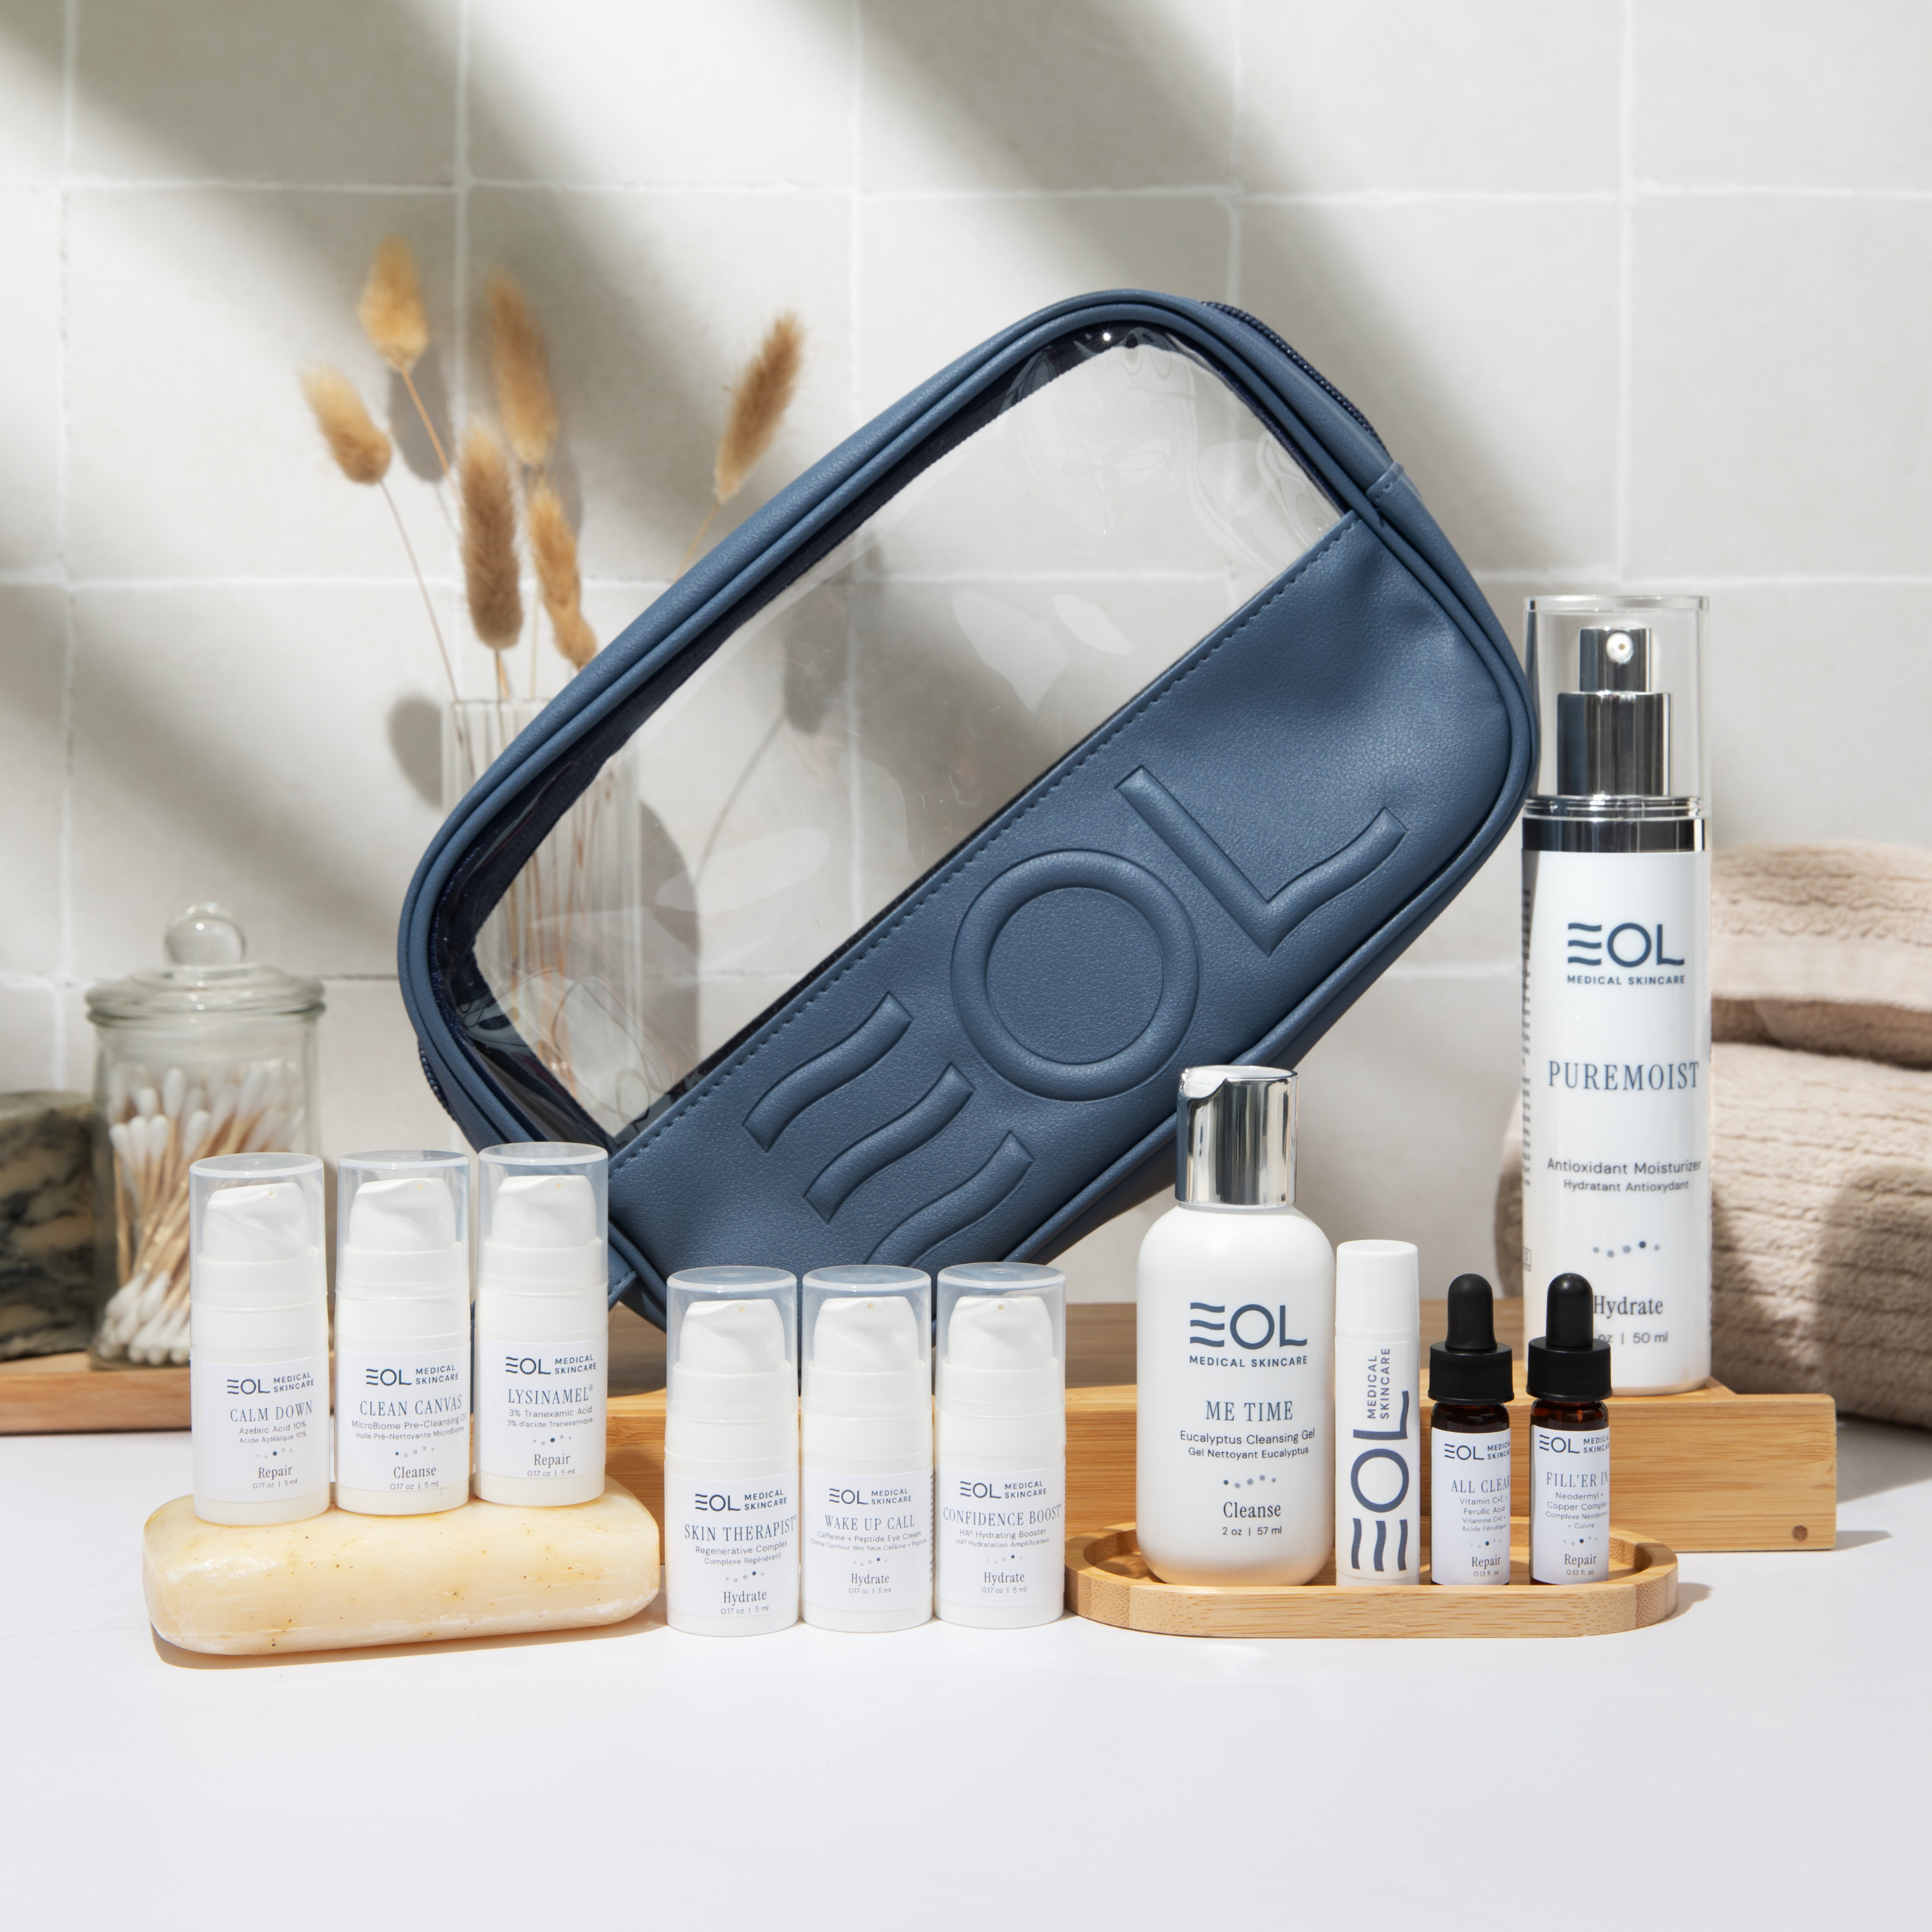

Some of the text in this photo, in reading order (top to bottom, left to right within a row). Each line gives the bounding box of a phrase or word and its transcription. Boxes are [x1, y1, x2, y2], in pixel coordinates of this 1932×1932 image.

[1567, 922, 1685, 967] EOL
[1567, 975, 1685, 985] MEDICAL SKINCARE
[1548, 1060, 1699, 1090] PUREMOIST
[1548, 1158, 1702, 1174] Antioxidant Moisturizer
[1564, 1180, 1689, 1193] Hydratant Antioxydant
[1593, 1295, 1663, 1319] Hydrate
[1190, 1303, 1307, 1350] EOL
[1598, 1332, 1668, 1343] oz 50 ml
[506, 1357, 551, 1375] EOL
[556, 1355, 593, 1365] MEDICAL
[1189, 1355, 1307, 1367] MEDICAL SKINCARE
[416, 1364, 455, 1375] MEDICAL
[555, 1362, 596, 1374] SKINCARE
[274, 1372, 311, 1383] MEDICAL
[366, 1369, 412, 1386] EOL
[416, 1373, 459, 1385] SKINCARE
[1381, 1348, 1390, 1419] SKINCARE
[227, 1379, 270, 1395] EOL
[274, 1379, 314, 1392] SKINCARE
[1367, 1356, 1377, 1419] MEDICAL
[230, 1401, 312, 1422] CALM DOWN
[360, 1395, 462, 1416] CLEAN CANVAS
[525, 1408, 574, 1418] Tranexamic
[577, 1406, 592, 1415] Acid
[1206, 1401, 1293, 1421] ME TIME
[273, 1424, 290, 1432] Acid
[294, 1421, 306, 1430] 10%
[352, 1420, 400, 1430] MicroBiome
[405, 1417, 459, 1430] Pre-Cleansing
[549, 1417, 593, 1428] Tranexamique
[1180, 1428, 1315, 1446] Eucalyptus Cleansing Gel
[1539, 1435, 1580, 1454] EOL
[1189, 1446, 1309, 1461] Gel Nettoyant Eucalyptus
[1444, 1444, 1484, 1460] EOL
[534, 1453, 570, 1468] Repair
[259, 1466, 292, 1481] Repair
[393, 1466, 436, 1479] Cleanse
[1546, 1471, 1597, 1488] FILL'ER
[1005, 1480, 1043, 1489] MEDICAL
[1350, 1390, 1409, 1572] EOL
[1451, 1480, 1475, 1493] ALL
[745, 1489, 783, 1501] MEDICAL
[829, 1488, 868, 1504] EOL
[872, 1488, 908, 1496] MEDICAL
[960, 1481, 1001, 1499] EOL
[1005, 1488, 1047, 1499] SKINCARE
[1556, 1492, 1599, 1501] Neodermyl
[696, 1494, 740, 1511] EOL
[745, 1497, 787, 1510] SKINCARE
[871, 1496, 911, 1504] SKINCARE
[1547, 1501, 1578, 1511] Copper
[1223, 1501, 1281, 1518] Cleanse
[1493, 1505, 1506, 1513] Acid
[1546, 1511, 1579, 1520] Complexe
[825, 1514, 915, 1531] WAKE UP CALL
[944, 1507, 1024, 1526] CONFIDENCE
[685, 1525, 716, 1541] SKIN
[818, 1531, 922, 1543] Caffeine Peptide Eye Cream
[976, 1529, 1046, 1540] Hydrating Booster
[1222, 1527, 1227, 1535] 2
[1257, 1527, 1268, 1535] 57
[1272, 1526, 1281, 1534] ml
[696, 1540, 787, 1556] Regenerative Complex
[1011, 1537, 1050, 1548] Amplificateur
[1472, 1555, 1501, 1569] Repair
[1565, 1553, 1597, 1567] Repair
[851, 1573, 889, 1586] Hydrate
[984, 1572, 1024, 1586] Hydrate
[724, 1591, 766, 1606] Hydrate
